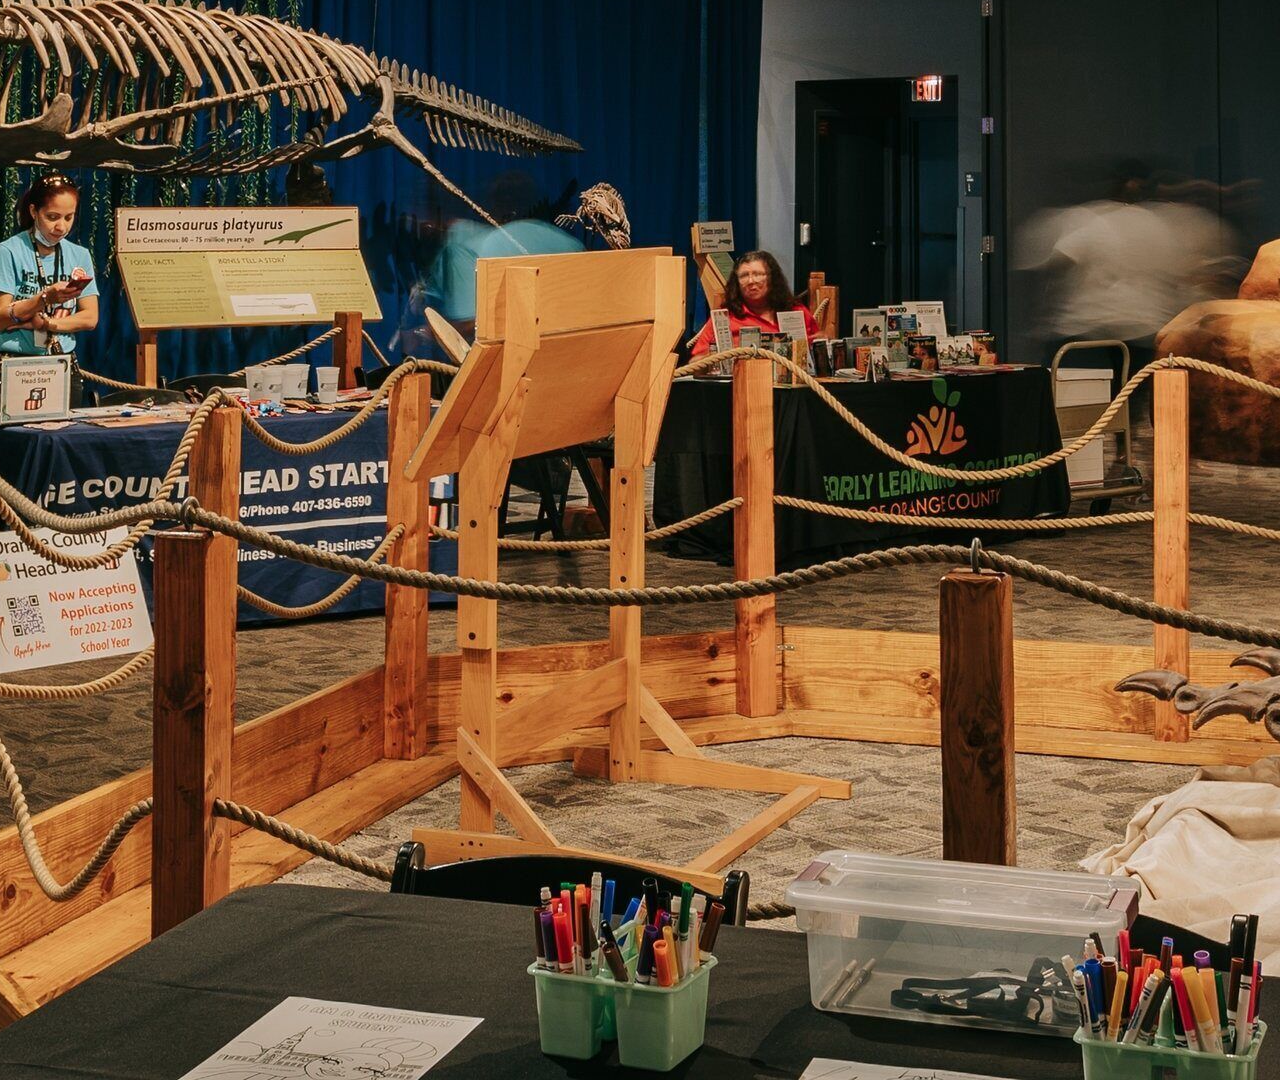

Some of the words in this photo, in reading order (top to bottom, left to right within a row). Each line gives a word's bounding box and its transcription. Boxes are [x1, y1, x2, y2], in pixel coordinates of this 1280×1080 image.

[916, 80, 937, 101] EXIT
[127, 218, 218, 231] Elasmosaurus
[222, 218, 284, 234] platyurus
[83, 475, 189, 499] COUNT
[239, 504, 289, 518] 6/Phone
[292, 495, 372, 513] 407-836-6590
[888, 496, 946, 516] ORANGE
[948, 488, 1001, 510] COUNTY
[52, 531, 108, 547] County
[15, 563, 57, 579] Head
[48, 591, 75, 603] Now
[78, 582, 136, 599] Accepting
[60, 600, 134, 620] Applications
[70, 625, 83, 637] for
[85, 618, 133, 634] 2022-2023
[80, 639, 110, 654] School
[111, 637, 131, 650] Year
